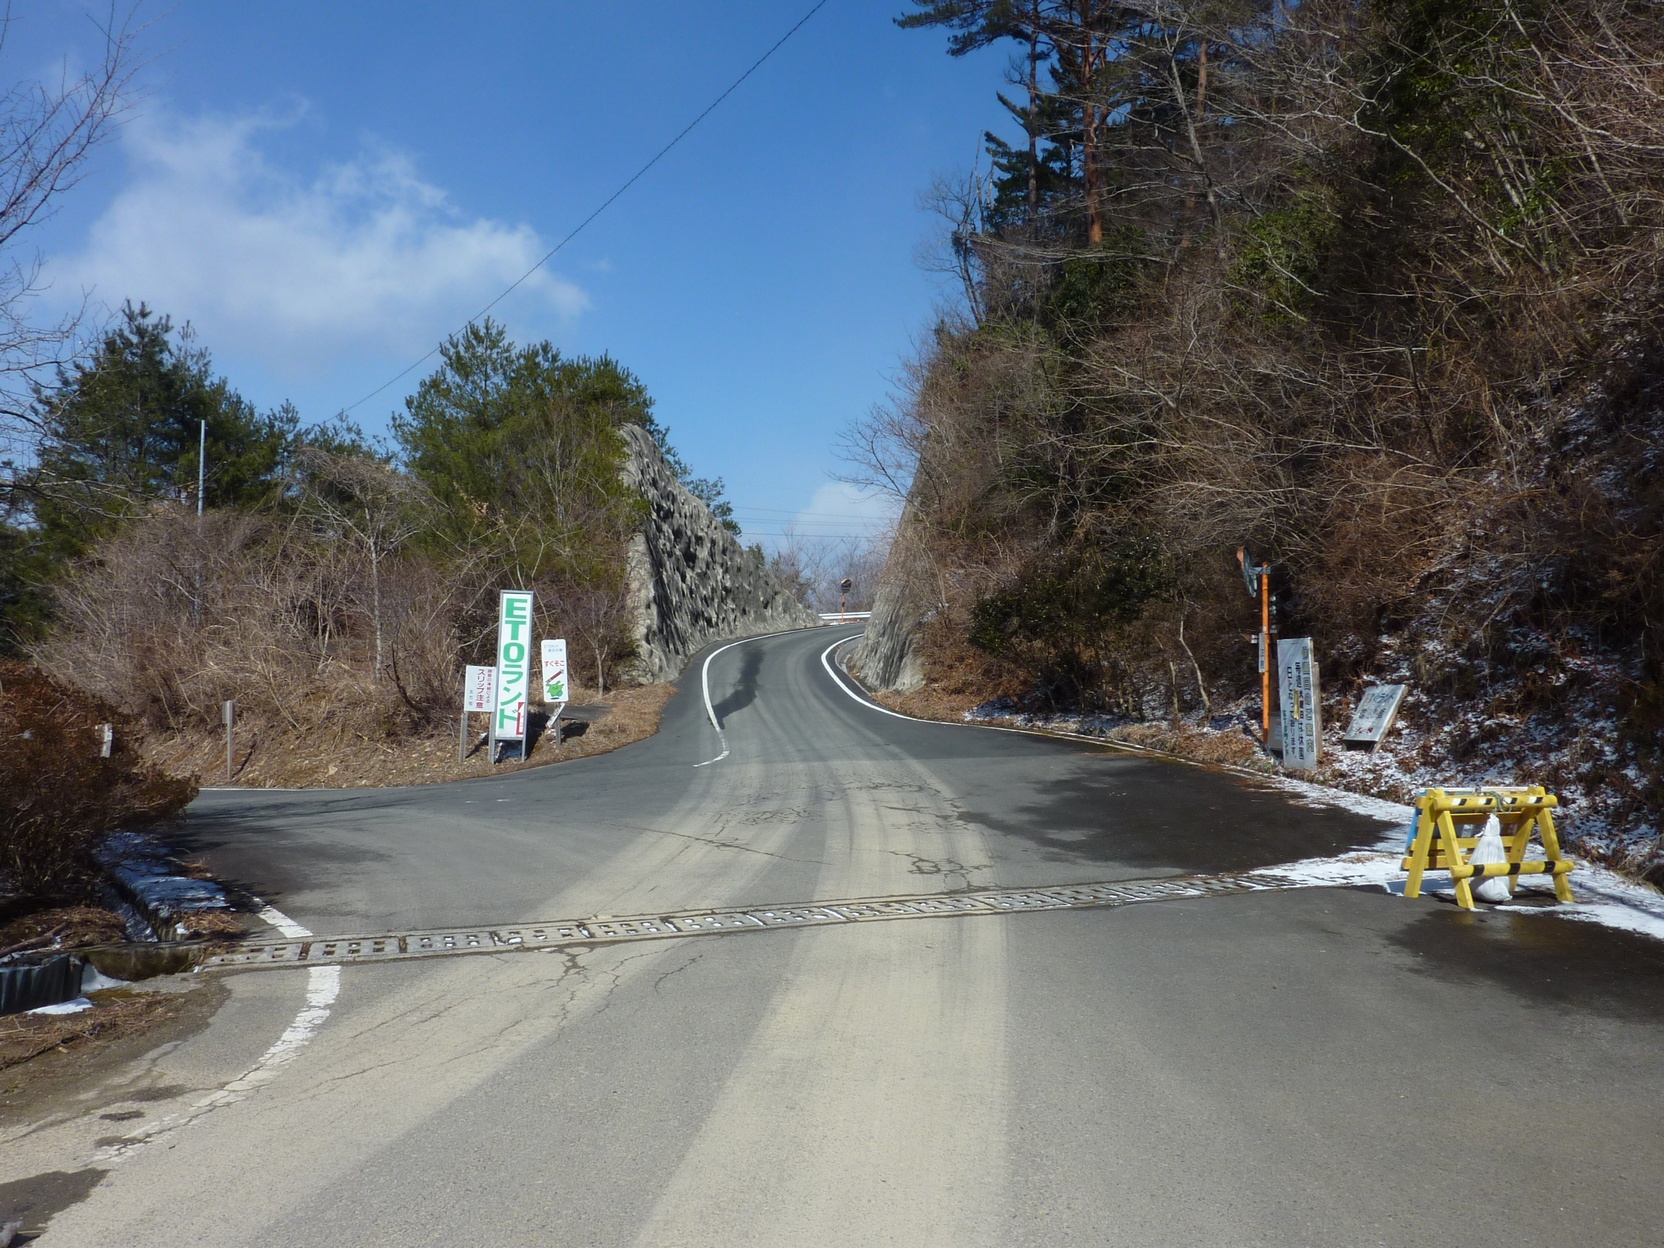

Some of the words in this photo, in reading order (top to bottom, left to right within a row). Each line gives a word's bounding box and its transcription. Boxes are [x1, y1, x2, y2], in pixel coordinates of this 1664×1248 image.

[476, 669, 485, 708] スリップ注意
[498, 598, 528, 729] ETOランド
